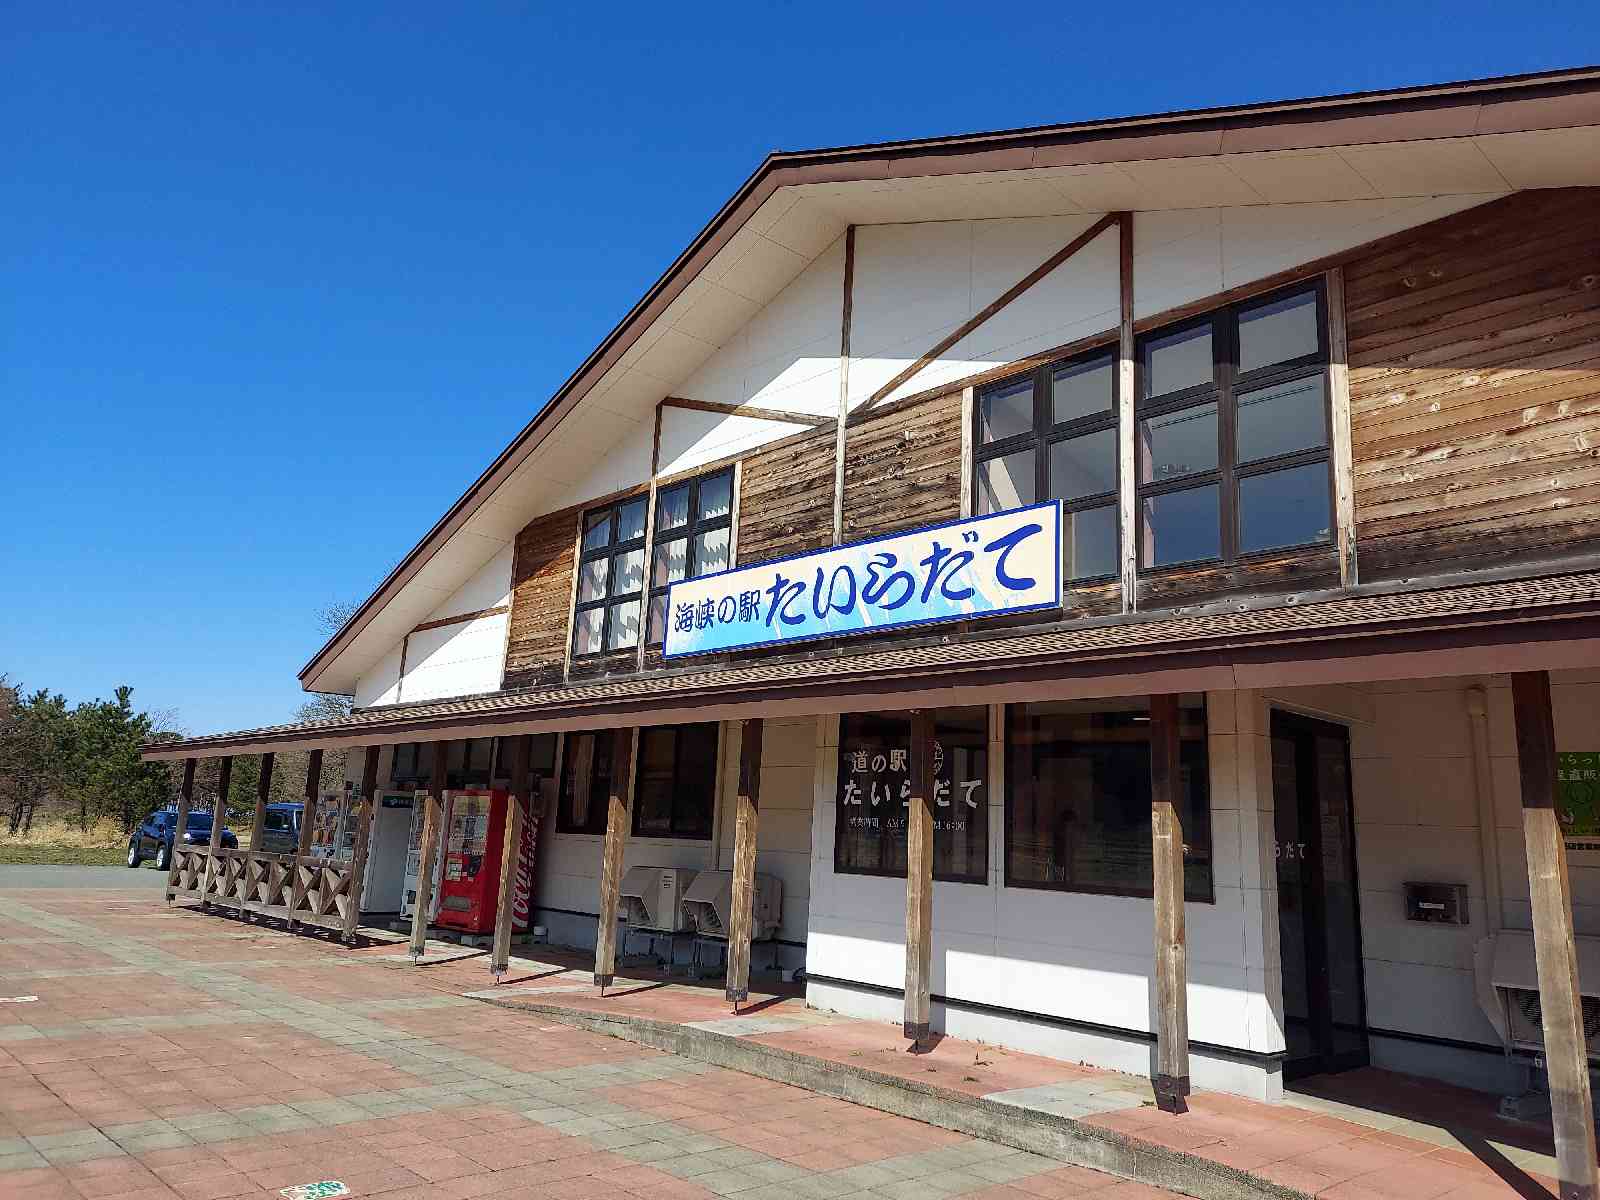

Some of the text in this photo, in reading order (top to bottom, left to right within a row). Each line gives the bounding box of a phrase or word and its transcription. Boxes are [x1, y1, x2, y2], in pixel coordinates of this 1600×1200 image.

[674, 523, 1042, 634] 海峡の駅 たいらだて
[852, 750, 907, 773] 道の駅
